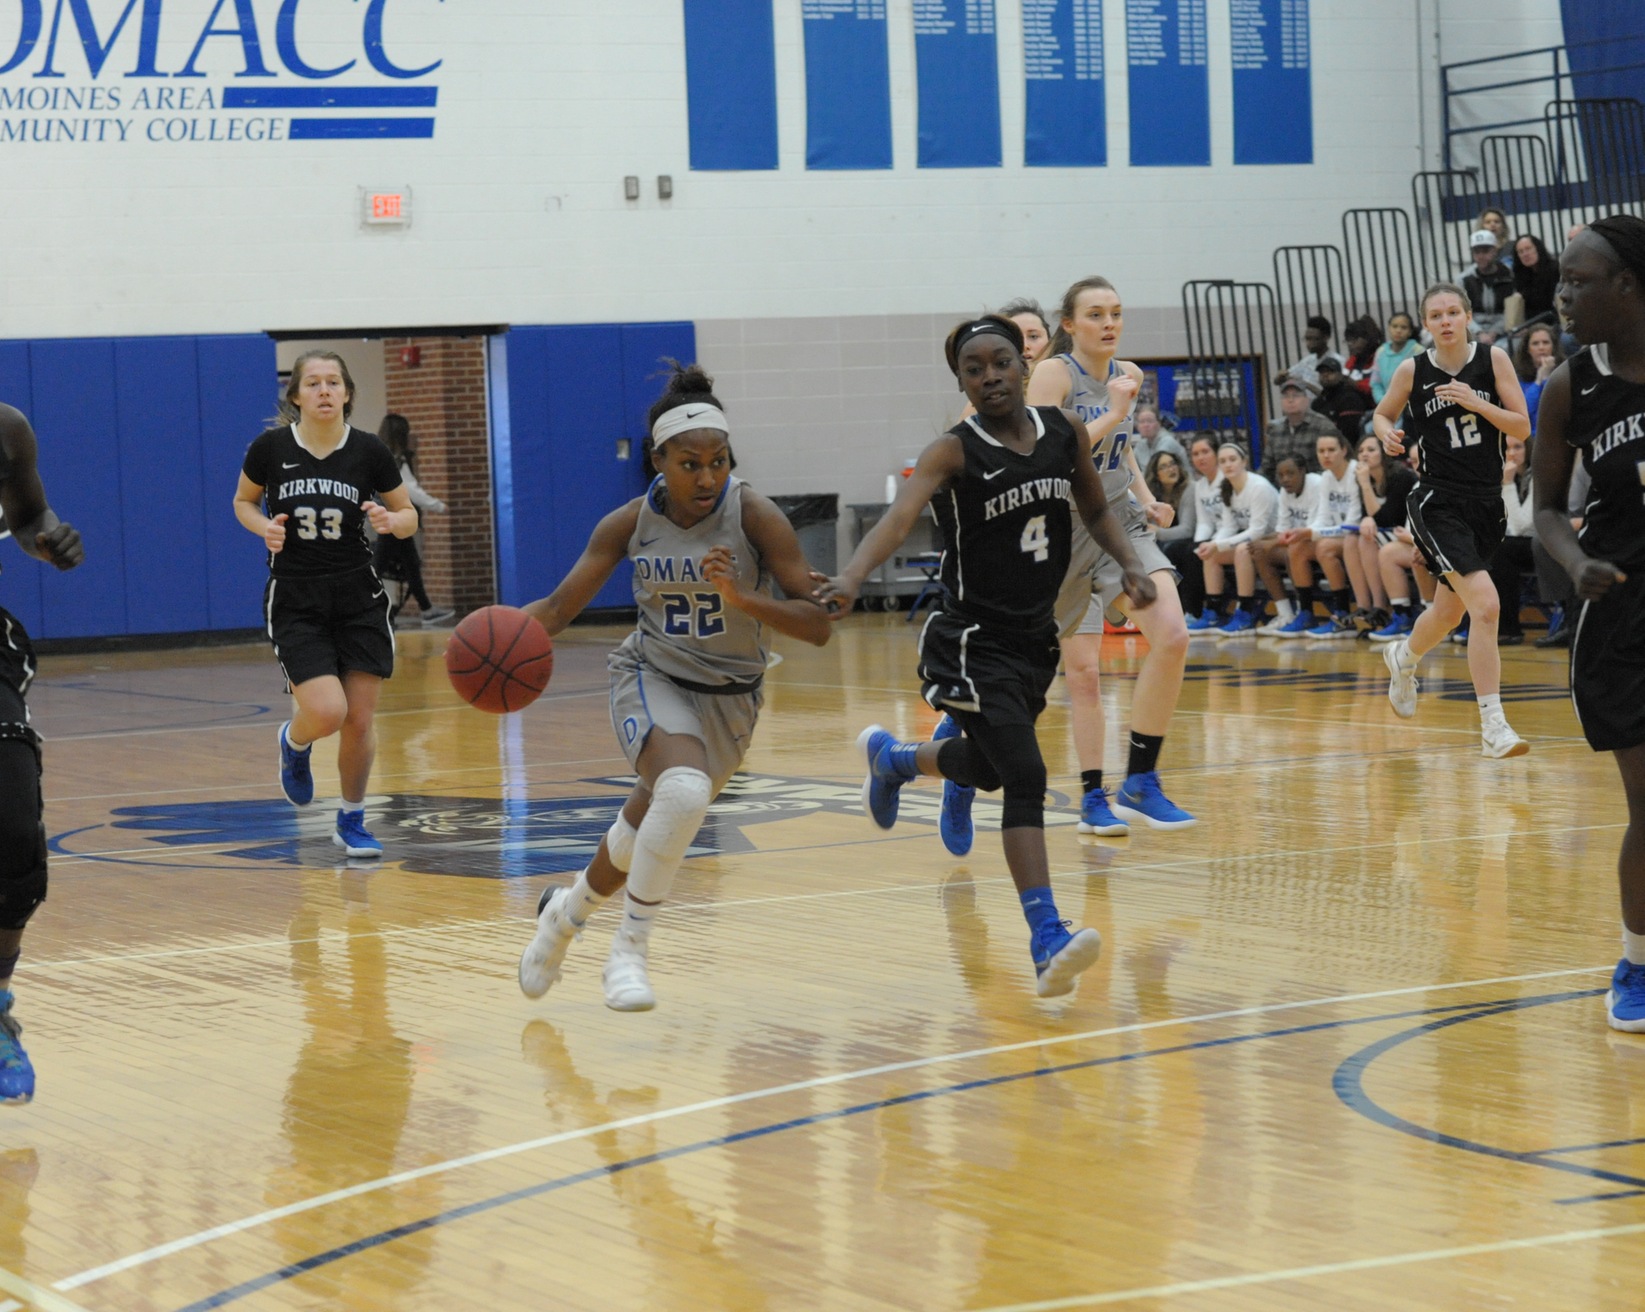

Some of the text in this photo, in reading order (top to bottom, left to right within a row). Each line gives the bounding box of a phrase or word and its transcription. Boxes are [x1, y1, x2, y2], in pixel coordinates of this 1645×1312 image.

[0, 86, 216, 111] MOINES AREA
[0, 117, 284, 142] MUNITY COLLEGE
[372, 194, 402, 218] EXIT
[1445, 413, 1482, 449] 12
[1591, 412, 1645, 463] KIRK
[278, 478, 360, 505] KIRKWOOD
[294, 506, 343, 541] 33
[1020, 514, 1050, 563] 4
[634, 556, 742, 584] DMA
[658, 592, 727, 639] 22
[621, 714, 640, 749] D
